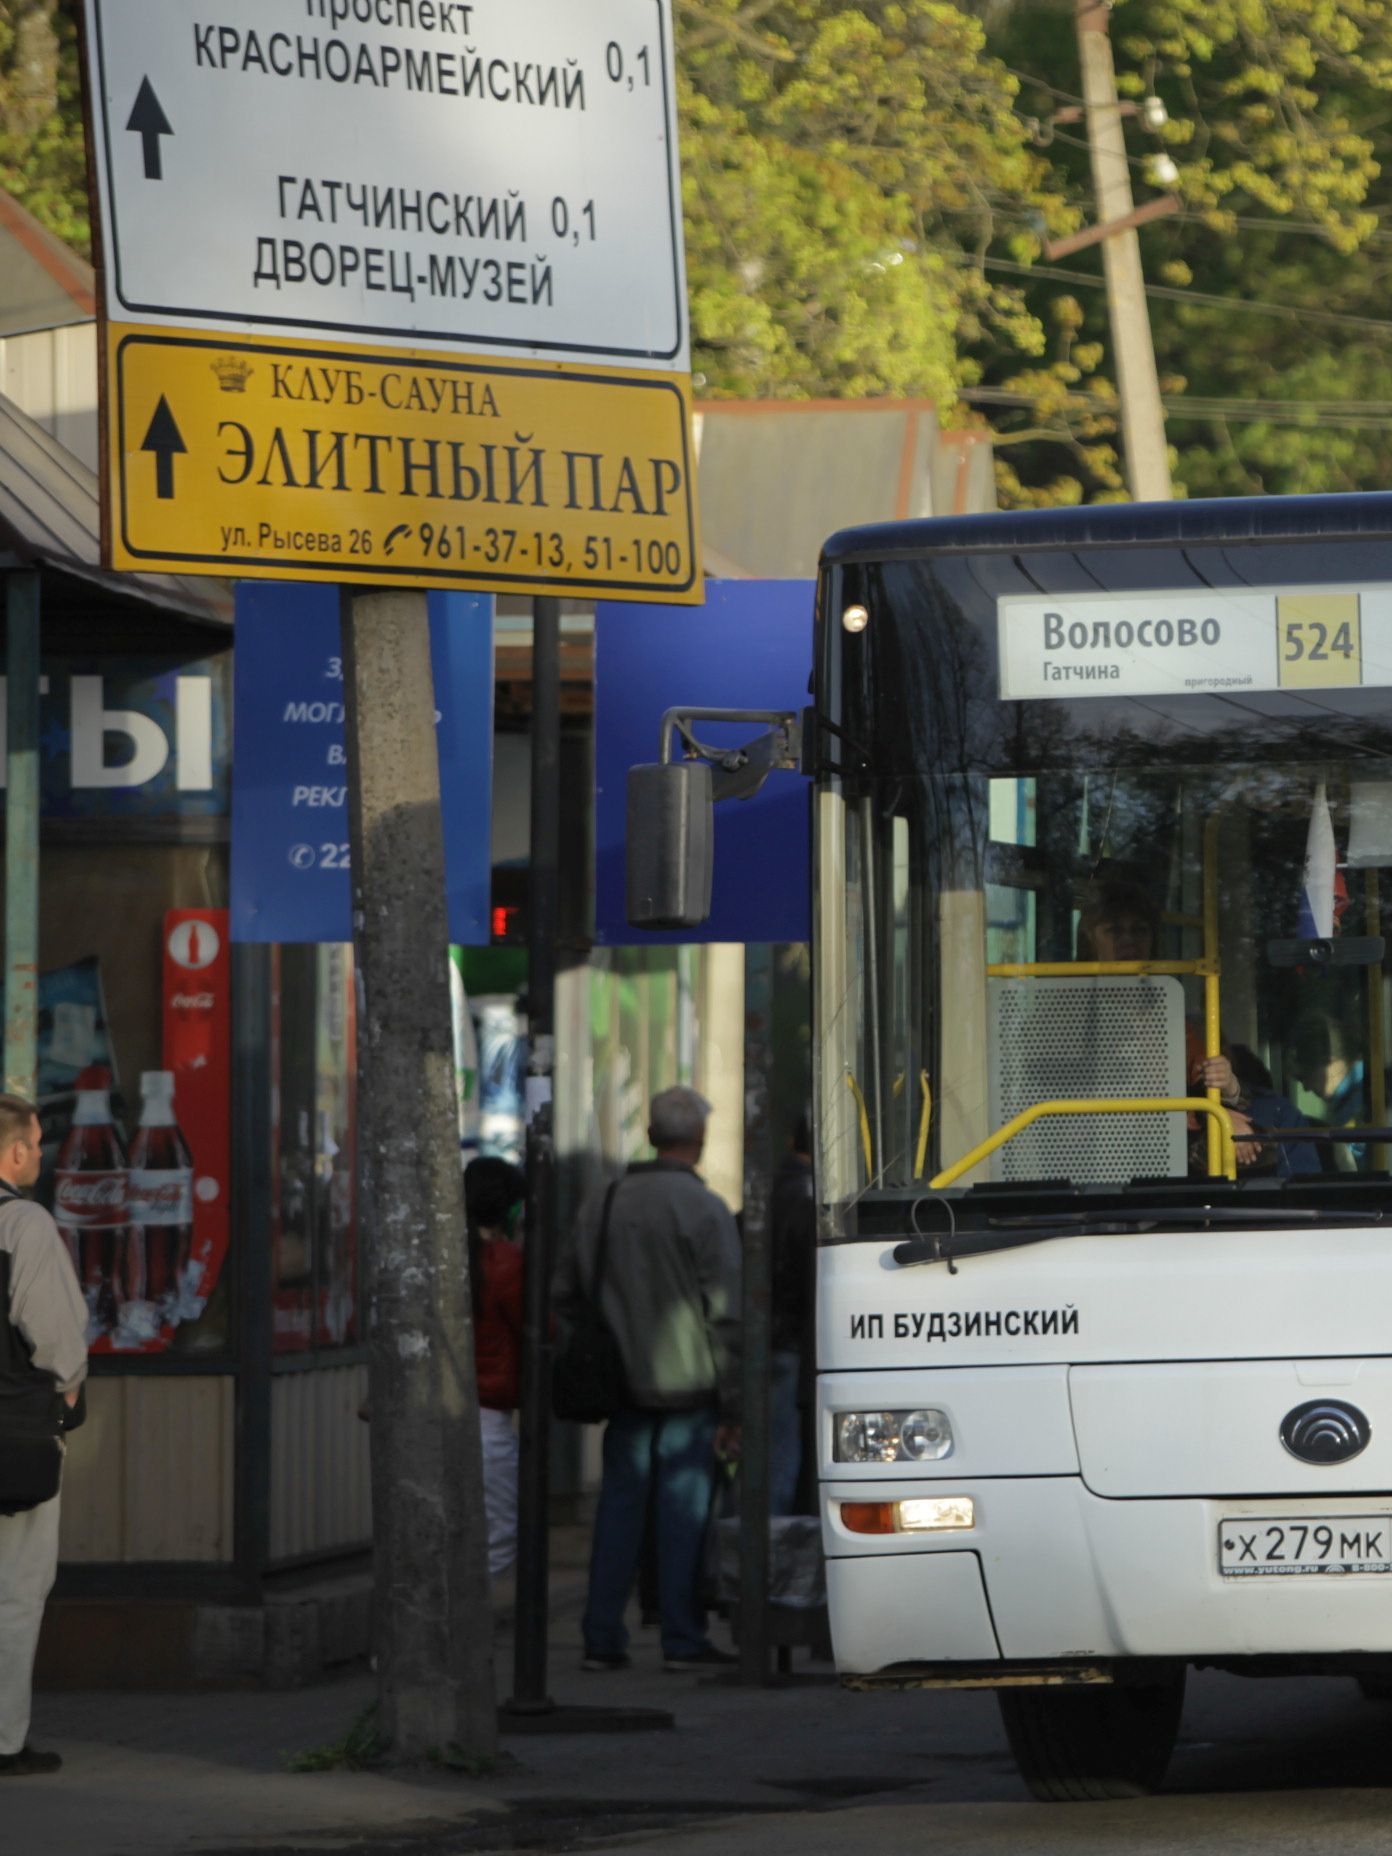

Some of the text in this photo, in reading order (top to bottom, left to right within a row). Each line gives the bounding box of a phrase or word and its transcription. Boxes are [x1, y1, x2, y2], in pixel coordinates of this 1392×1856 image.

[194, 23, 586, 111] КРАСНОАРМЕЙСКИЙ
[606, 41, 651, 92] 0,1
[278, 175, 596, 247] ГАТЧИНСКИЙ 0,1
[254, 237, 554, 307] ДВОРЕЦ-МУЗЕЙ
[271, 363, 502, 417] КЛУБ-САУНА
[217, 421, 681, 516] ЭЛИТНЫЙ ПАР
[220, 522, 681, 575] ул. Рысева 26 961-37-13, 51-100
[1043, 613, 1221, 650] Волосово
[1284, 622, 1354, 661] 524
[1043, 661, 1121, 681] Гатчина
[1184, 676, 1254, 689] пригородный
[850, 1303, 1079, 1343] ИП БУДЗИНСКИЙ
[1223, 1564, 1319, 1576] www.yutong.ru
